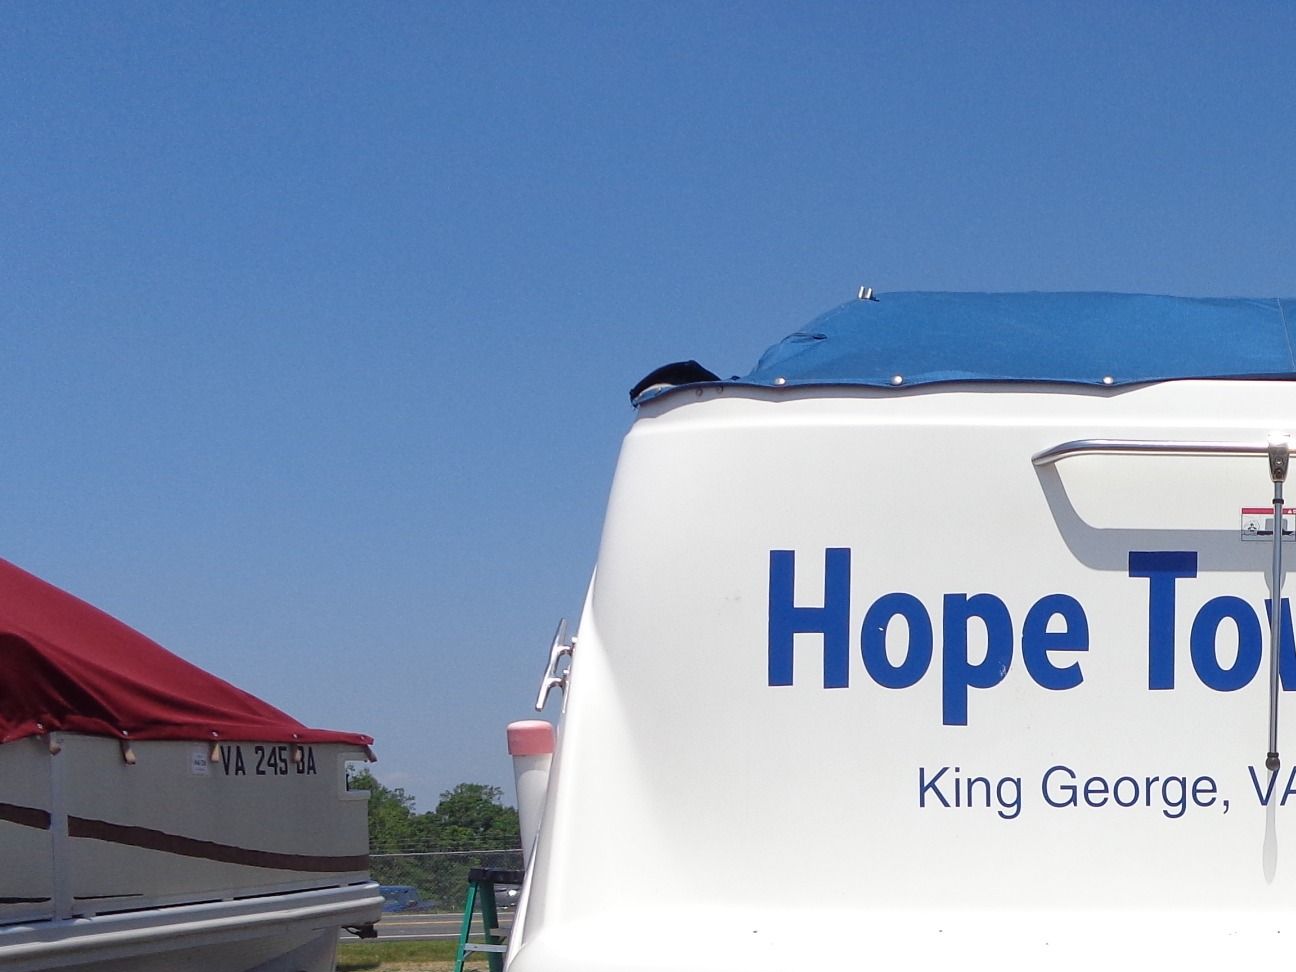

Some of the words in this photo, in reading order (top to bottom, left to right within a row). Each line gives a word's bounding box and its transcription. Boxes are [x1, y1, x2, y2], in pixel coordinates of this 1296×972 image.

[767, 547, 1090, 726] Hope
[220, 745, 246, 776] VA
[255, 745, 288, 775] 245
[917, 766, 1024, 820] King
[1041, 765, 1231, 820] George,
